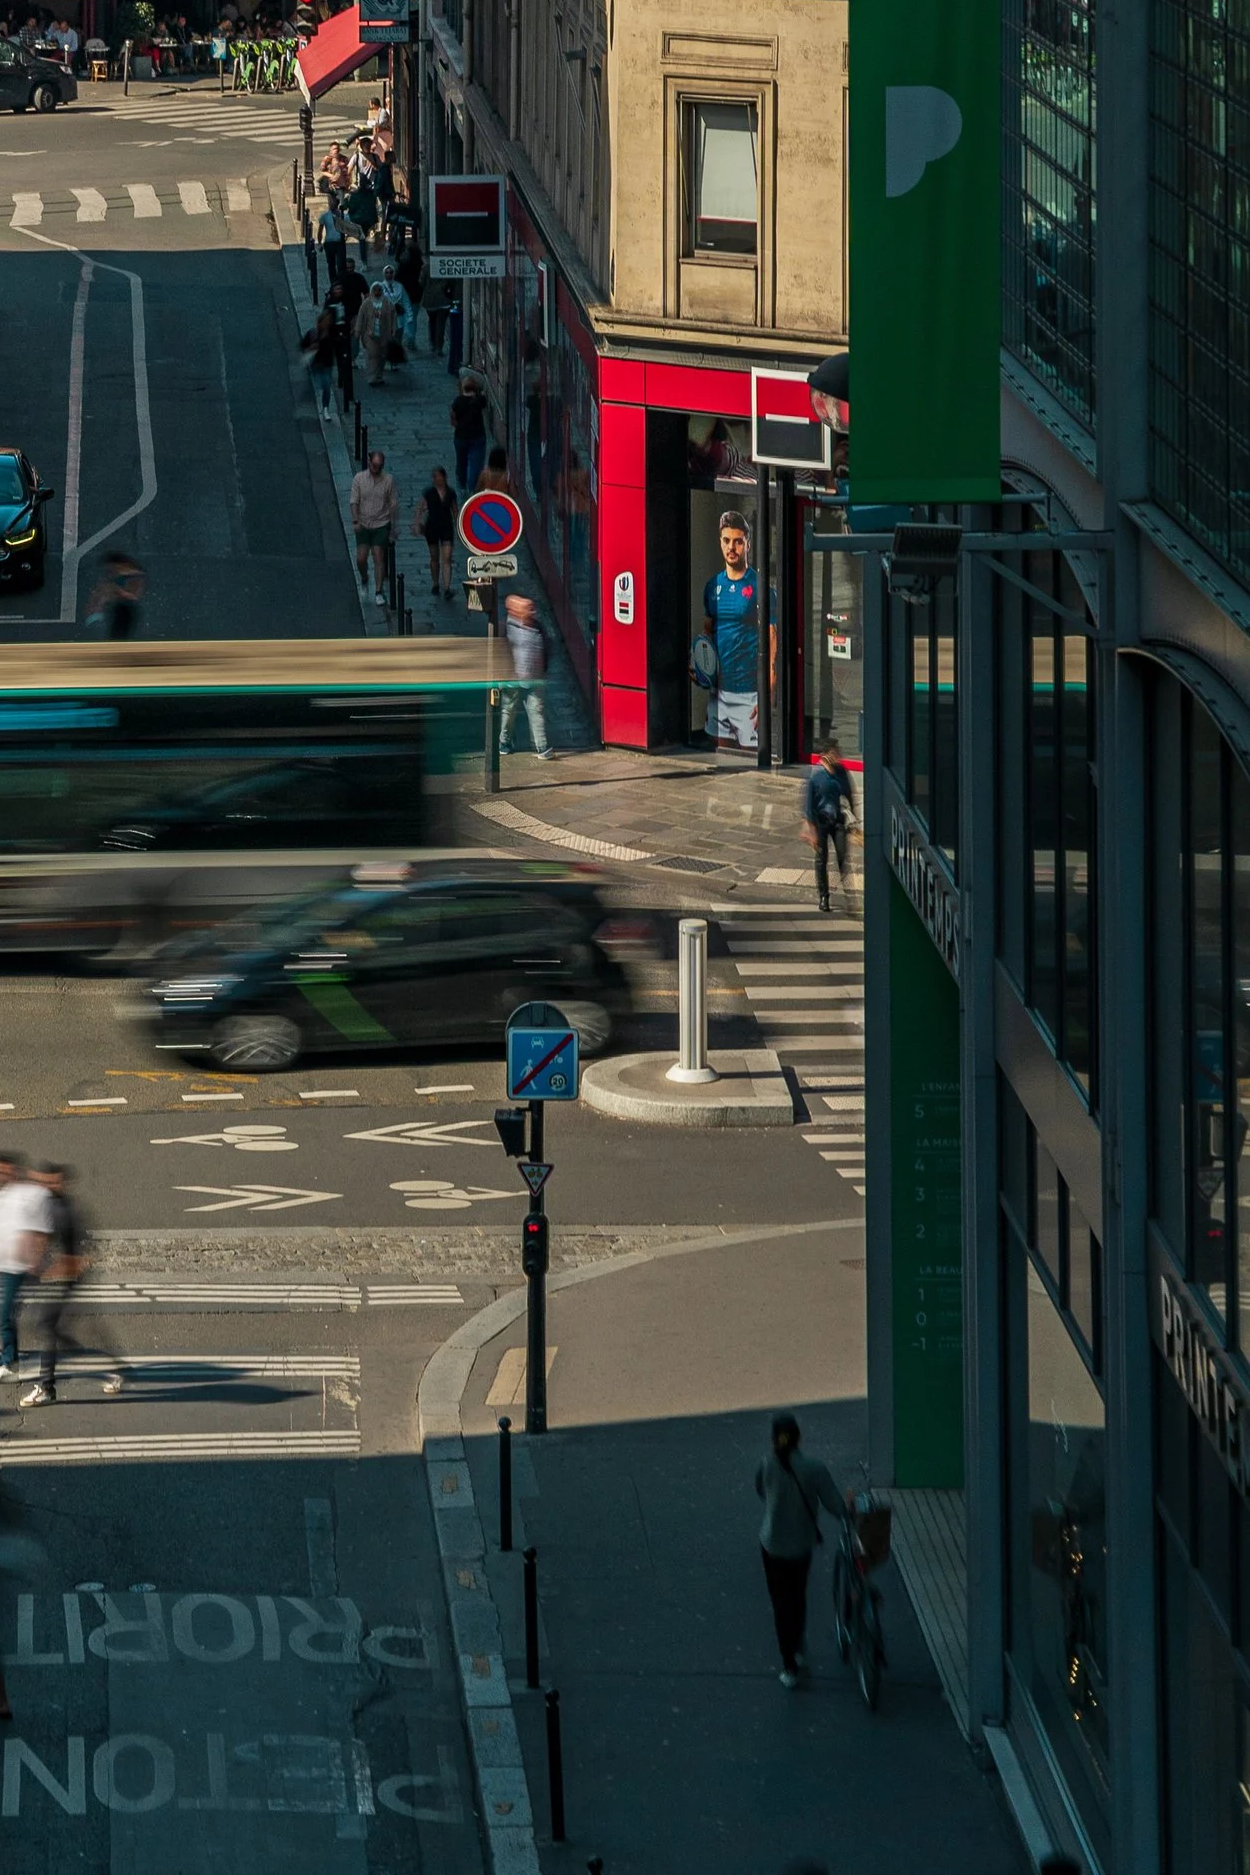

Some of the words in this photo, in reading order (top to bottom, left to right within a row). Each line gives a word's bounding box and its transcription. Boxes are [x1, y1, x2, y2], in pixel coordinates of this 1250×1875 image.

[439, 258, 486, 267] SOCIETE
[439, 266, 498, 275] GENERALE
[891, 805, 959, 976] PRINTEMPS
[553, 1077, 564, 1088] 20
[914, 1103, 924, 1119] 5
[916, 1138, 930, 1147] LA
[914, 1157, 925, 1171] 4
[915, 1187, 925, 1202] 3
[915, 1223, 925, 1239] 2
[919, 1264, 932, 1275] LA
[918, 1287, 925, 1302] 1
[916, 1311, 927, 1327] 0
[911, 1337, 926, 1351] -1
